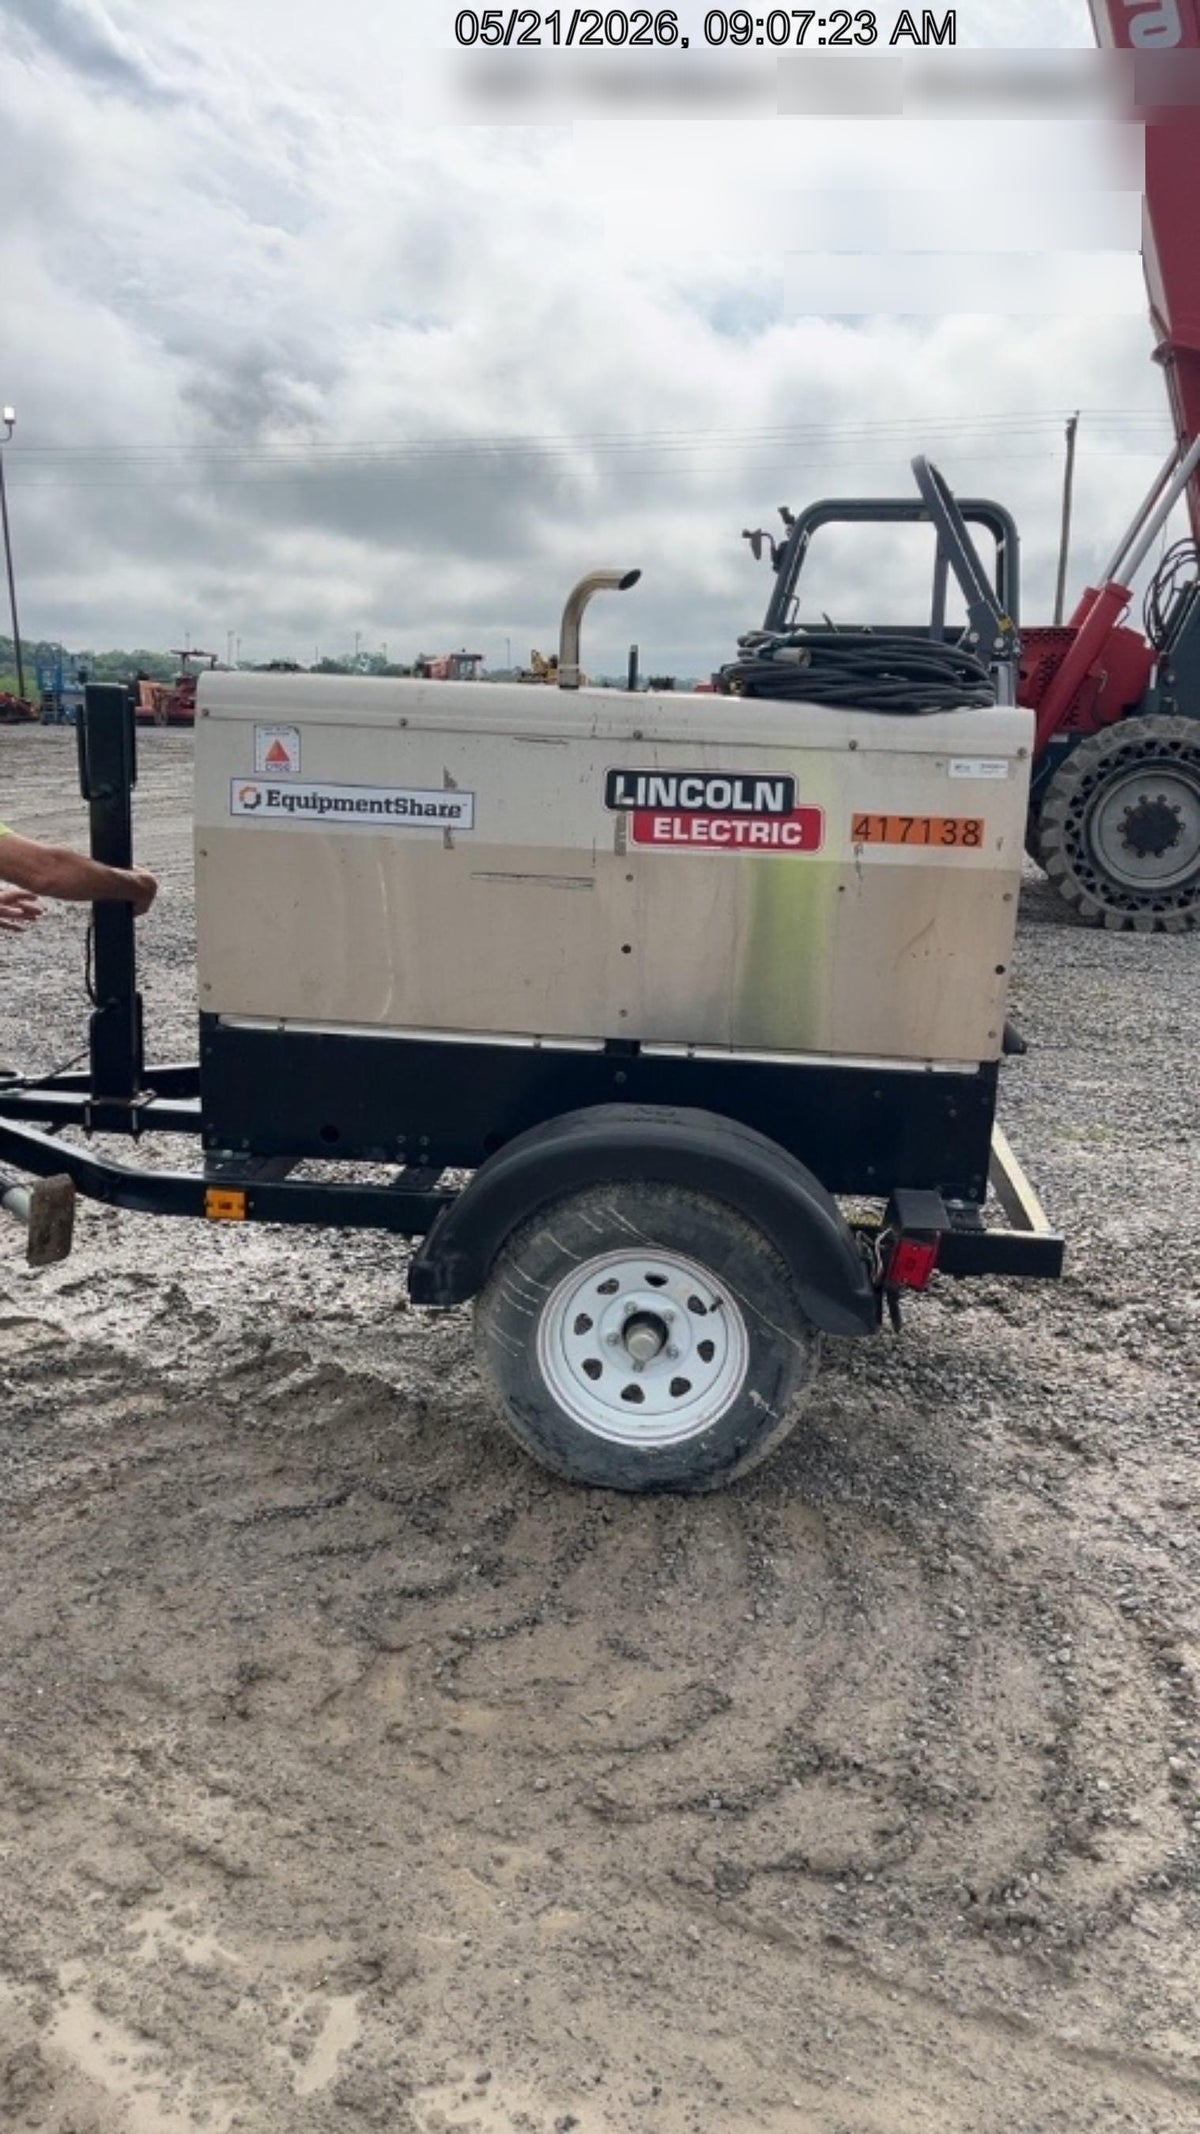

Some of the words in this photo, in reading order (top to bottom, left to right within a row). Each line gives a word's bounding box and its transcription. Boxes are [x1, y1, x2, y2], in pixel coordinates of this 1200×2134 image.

[266, 789, 461, 819] EquipmentShare
[614, 776, 784, 812] LINCOLN
[653, 817, 802, 845] ELECTRIC
[854, 815, 980, 846] 417138
